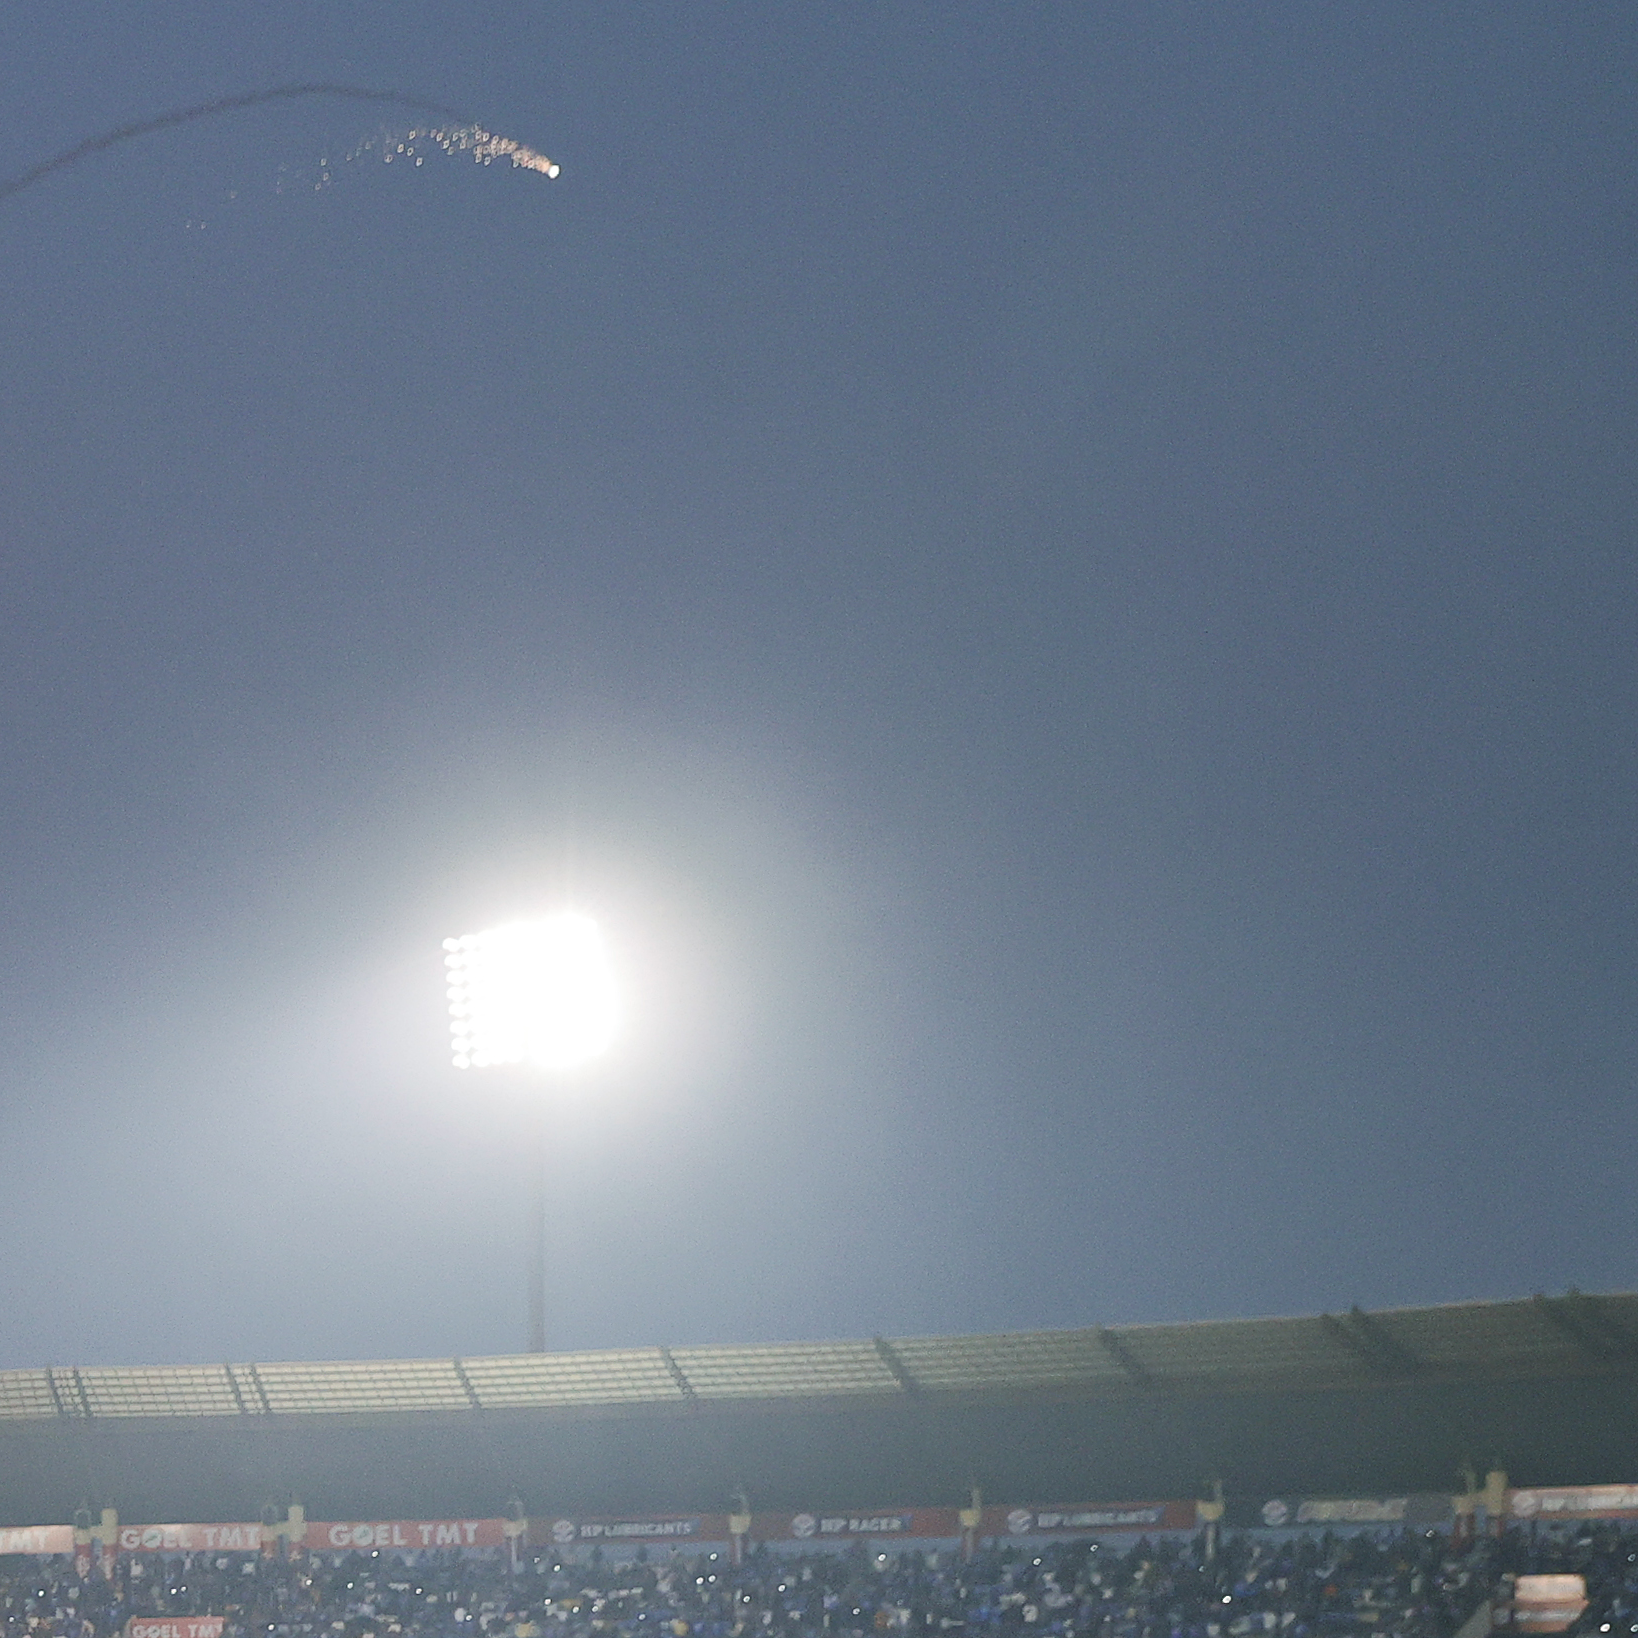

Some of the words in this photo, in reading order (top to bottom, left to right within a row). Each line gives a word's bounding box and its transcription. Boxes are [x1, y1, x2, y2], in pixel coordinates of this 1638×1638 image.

[123, 1526, 193, 1549] GOEL
[205, 1526, 261, 1548] TMT
[328, 1524, 407, 1547] GOEL
[419, 1522, 478, 1545] TMT
